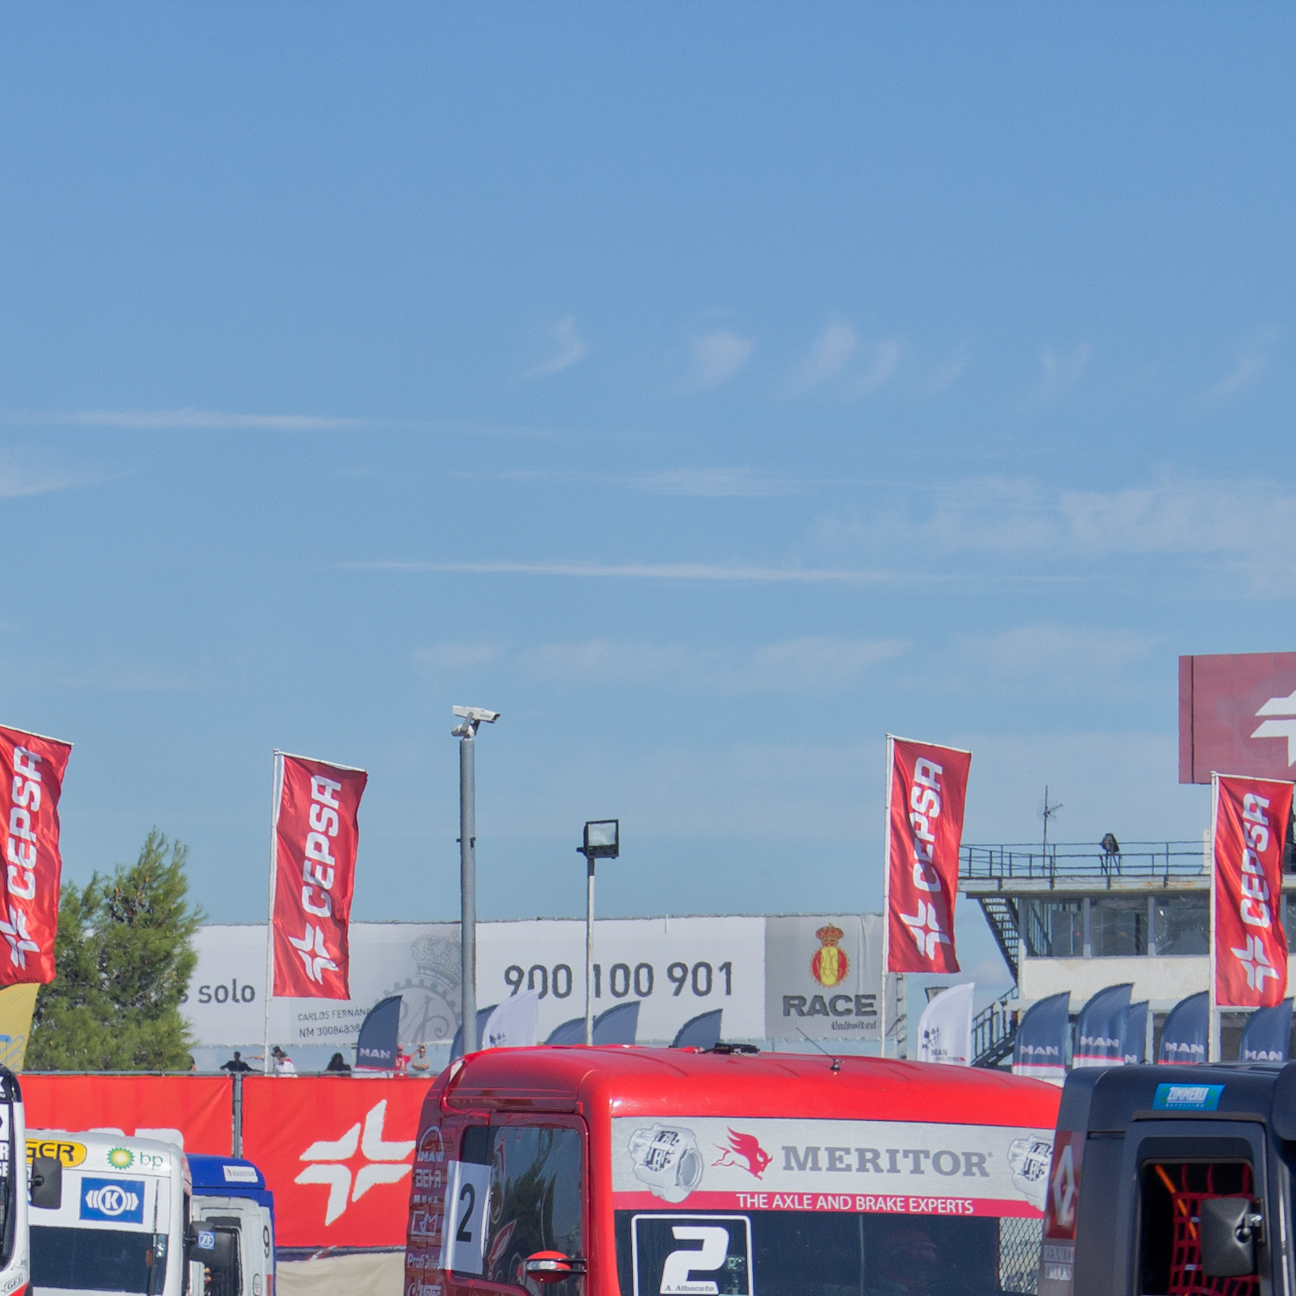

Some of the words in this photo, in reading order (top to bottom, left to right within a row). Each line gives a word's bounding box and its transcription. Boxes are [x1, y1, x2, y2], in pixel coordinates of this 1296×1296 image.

[7, 745, 43, 900] CEPSA
[912, 756, 943, 892] CEPSA
[302, 774, 341, 917] CEPSA
[1241, 792, 1270, 928] CEPSA
[198, 979, 256, 1004] solo
[504, 964, 573, 1000] 900
[592, 962, 654, 998] 100
[667, 961, 733, 997] 901
[781, 994, 878, 1018] RACE
[831, 1019, 878, 1031] Unlimited
[1019, 1045, 1060, 1057] MAN
[1080, 1035, 1120, 1048] MAN
[1165, 1042, 1205, 1055] MAN
[359, 1046, 391, 1060] MAN
[1244, 1049, 1284, 1062] MAN
[140, 1152, 164, 1168] bp
[417, 1151, 444, 1162] MAN
[781, 1144, 991, 1178] MERITOR
[455, 1183, 476, 1243] 2
[736, 1193, 769, 1209] THE
[772, 1194, 815, 1210] AXLE
[817, 1195, 852, 1211] AND
[855, 1196, 906, 1212] BRAKE
[908, 1197, 975, 1214] EXPERTS
[200, 1234, 214, 1246] ZF
[659, 1225, 731, 1295] 2
